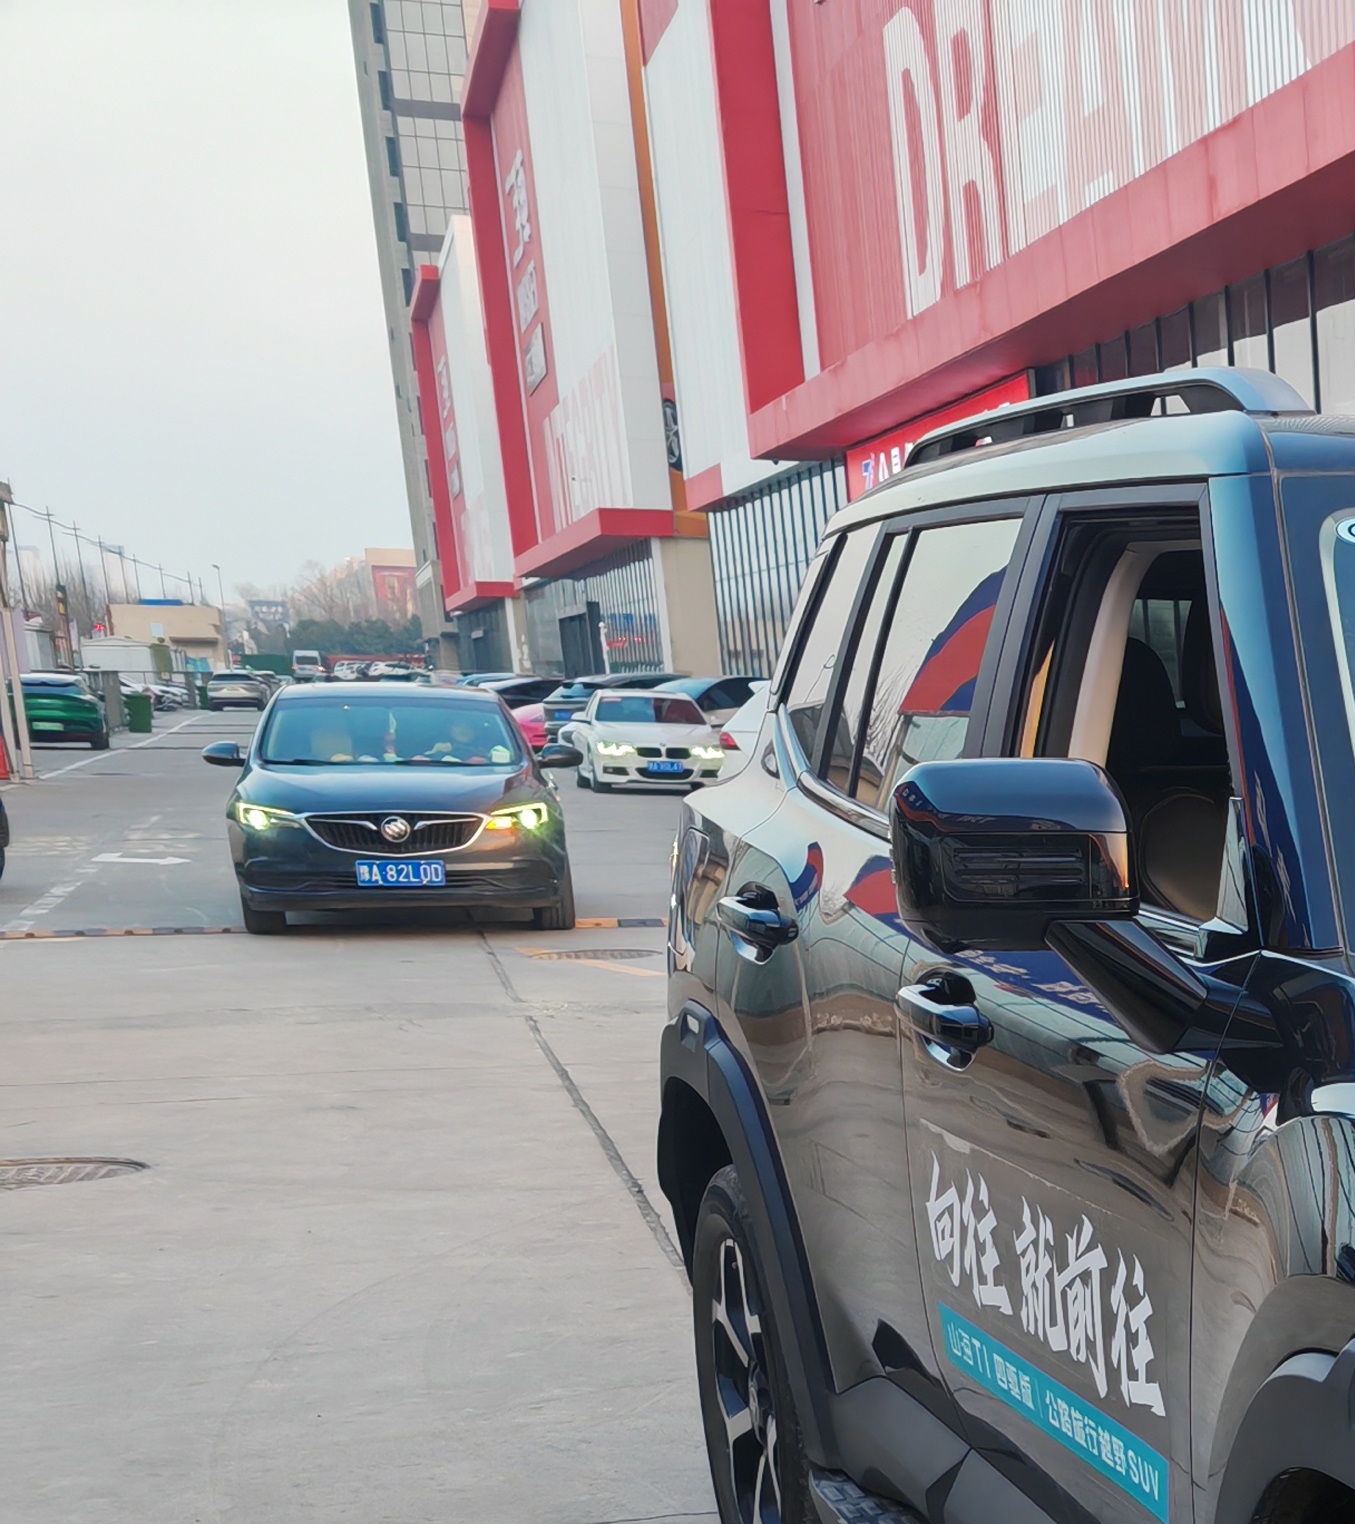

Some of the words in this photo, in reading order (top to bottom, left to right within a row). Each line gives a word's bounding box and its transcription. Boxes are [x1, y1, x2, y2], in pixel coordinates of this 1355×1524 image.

[926, 1150, 1013, 1316] 向往
[1013, 1195, 1166, 1417] 就前往
